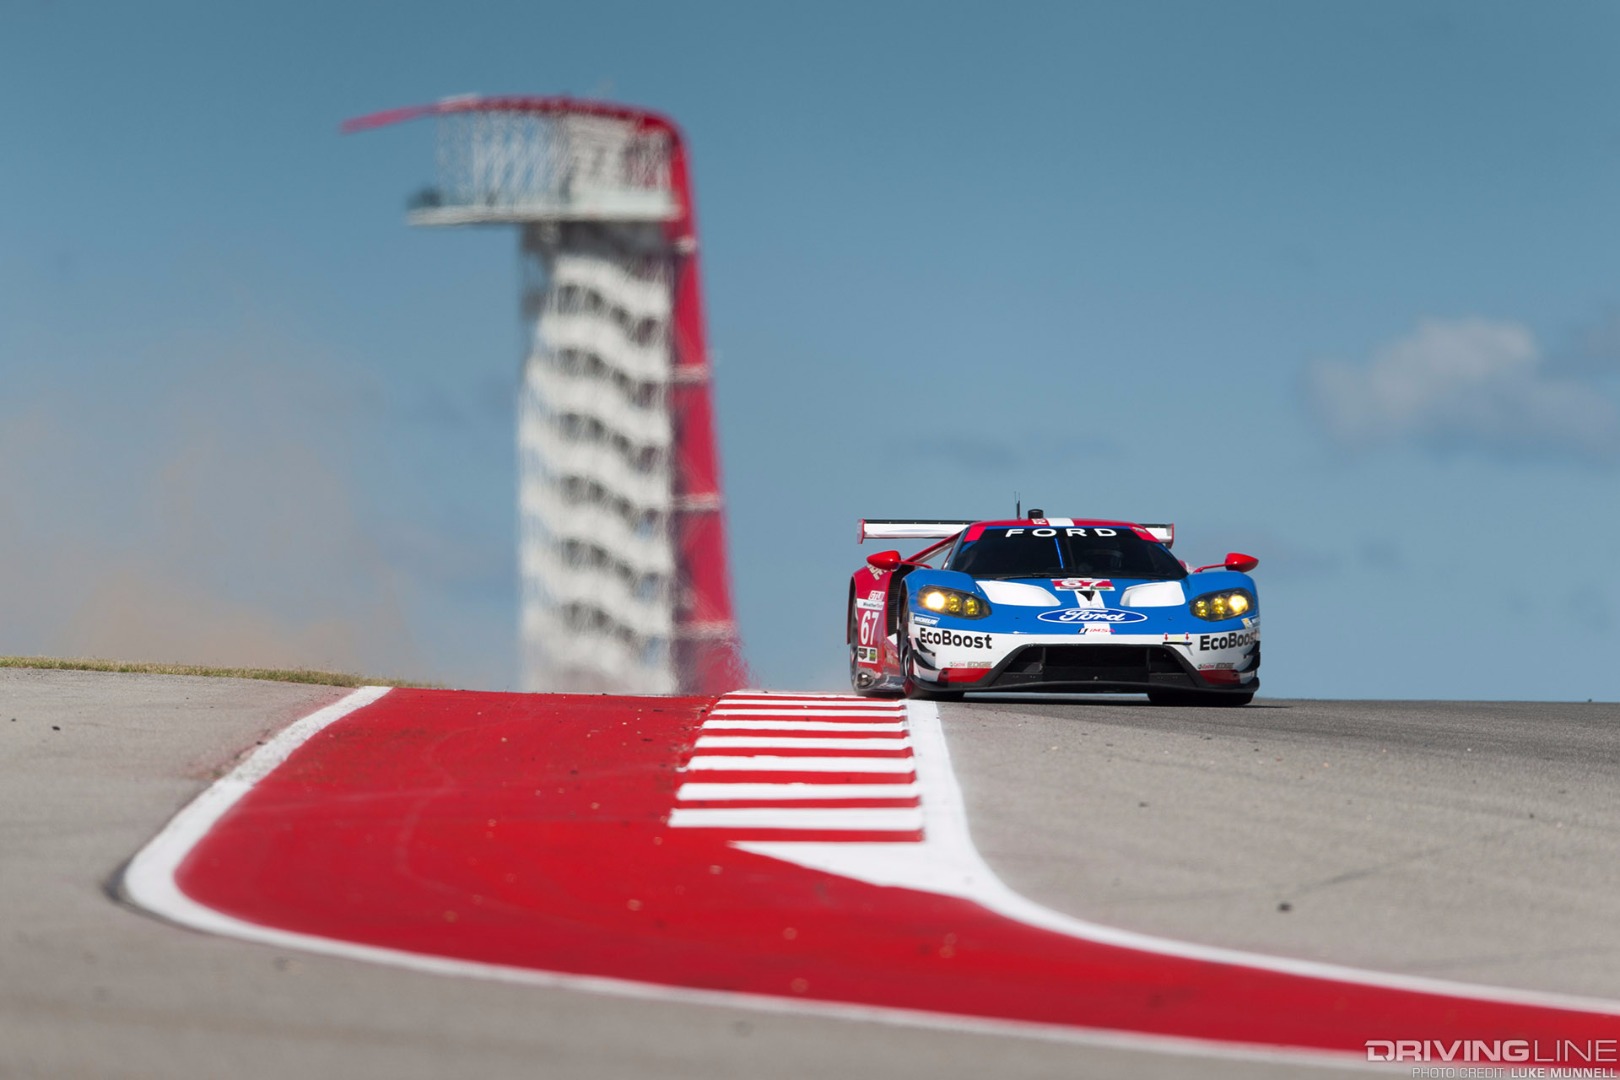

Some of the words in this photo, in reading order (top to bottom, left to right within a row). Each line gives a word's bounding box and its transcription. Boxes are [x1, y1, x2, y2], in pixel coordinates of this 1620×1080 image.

[1005, 527, 1117, 538] FORD
[1061, 578, 1105, 588] 67
[1059, 608, 1127, 621] Ford
[860, 610, 880, 646] 67
[919, 627, 993, 649] EcoBoost
